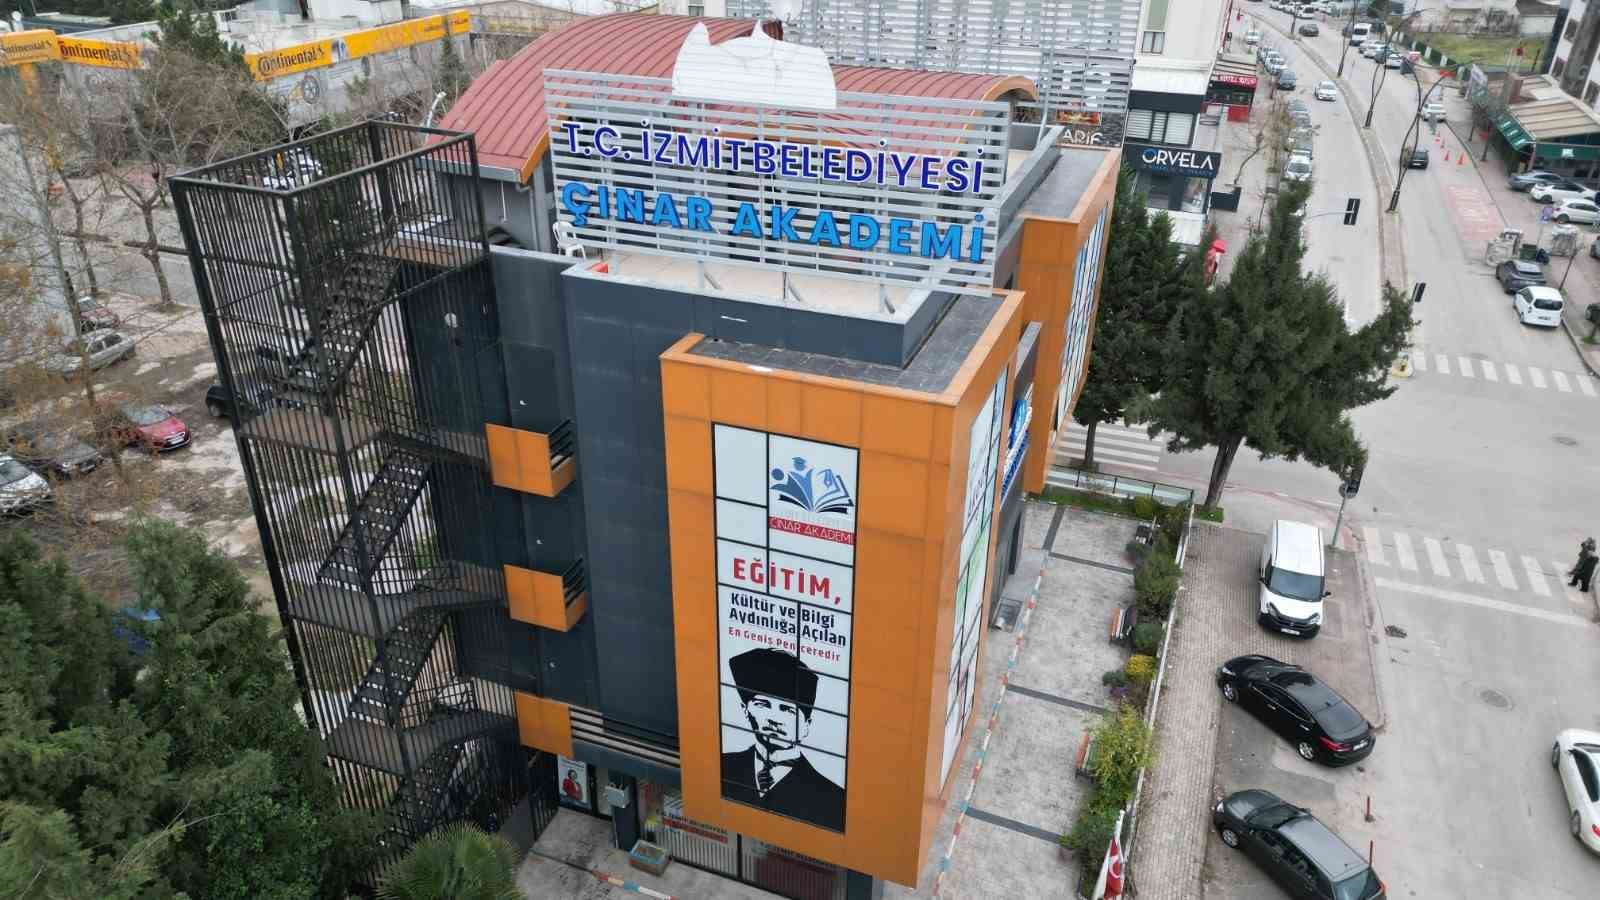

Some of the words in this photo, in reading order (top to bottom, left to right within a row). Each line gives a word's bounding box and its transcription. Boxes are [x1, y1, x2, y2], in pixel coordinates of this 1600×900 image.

[257, 47, 318, 76] Continental
[561, 121, 632, 161] T.C.
[641, 119, 747, 171] İZMİT
[753, 138, 984, 193] BELEDİYESİ
[1142, 147, 1214, 170] ORVELA
[561, 181, 714, 232] ÇINAR
[732, 202, 985, 264] AKADEMİ
[733, 557, 842, 606] EĞİTİM,
[729, 607, 797, 635] Aydınlığa
[802, 625, 847, 647] Açılan
[731, 592, 776, 613] Kültür
[779, 605, 796, 619] ve
[801, 608, 835, 629] Bilgi
[728, 626, 741, 637] En
